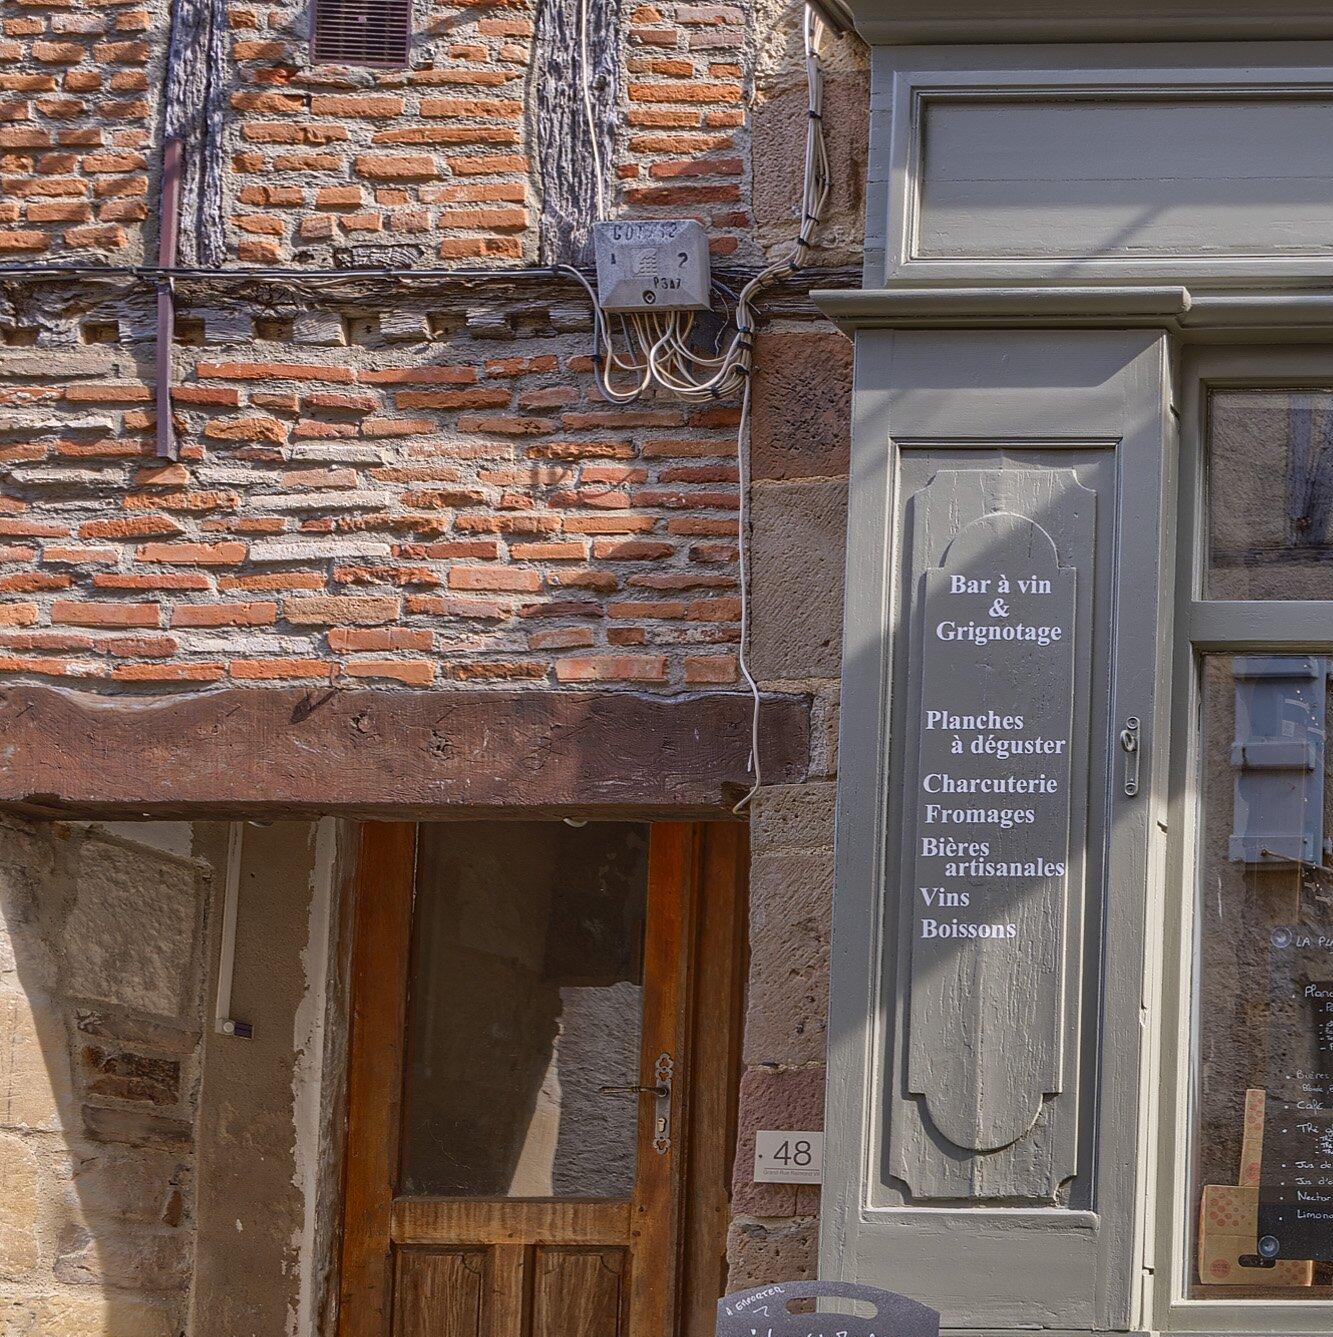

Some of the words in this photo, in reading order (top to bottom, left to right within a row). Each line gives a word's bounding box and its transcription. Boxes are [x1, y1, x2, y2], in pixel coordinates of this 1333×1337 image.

[950, 575, 991, 594] Bar
[998, 575, 1011, 594] à
[1017, 575, 1052, 594] vin
[988, 598, 1010, 618] &
[936, 621, 1062, 646] Grignotage
[925, 710, 1024, 730] Planches
[951, 735, 963, 754] à
[971, 734, 1066, 759] déguster
[923, 773, 1058, 793] Charcuterie
[925, 804, 1035, 829] Fromages
[921, 837, 990, 857] Bières
[945, 857, 1065, 877] artisanales
[919, 887, 970, 907] Vins
[921, 919, 1016, 939] Boissons
[1296, 937, 1310, 947] LA
[773, 1141, 811, 1166] 48
[1295, 1160, 1314, 1169] Jus
[1320, 1160, 1332, 1169] de
[1295, 1177, 1312, 1185] Jus
[1297, 1190, 1331, 1202] Nectar
